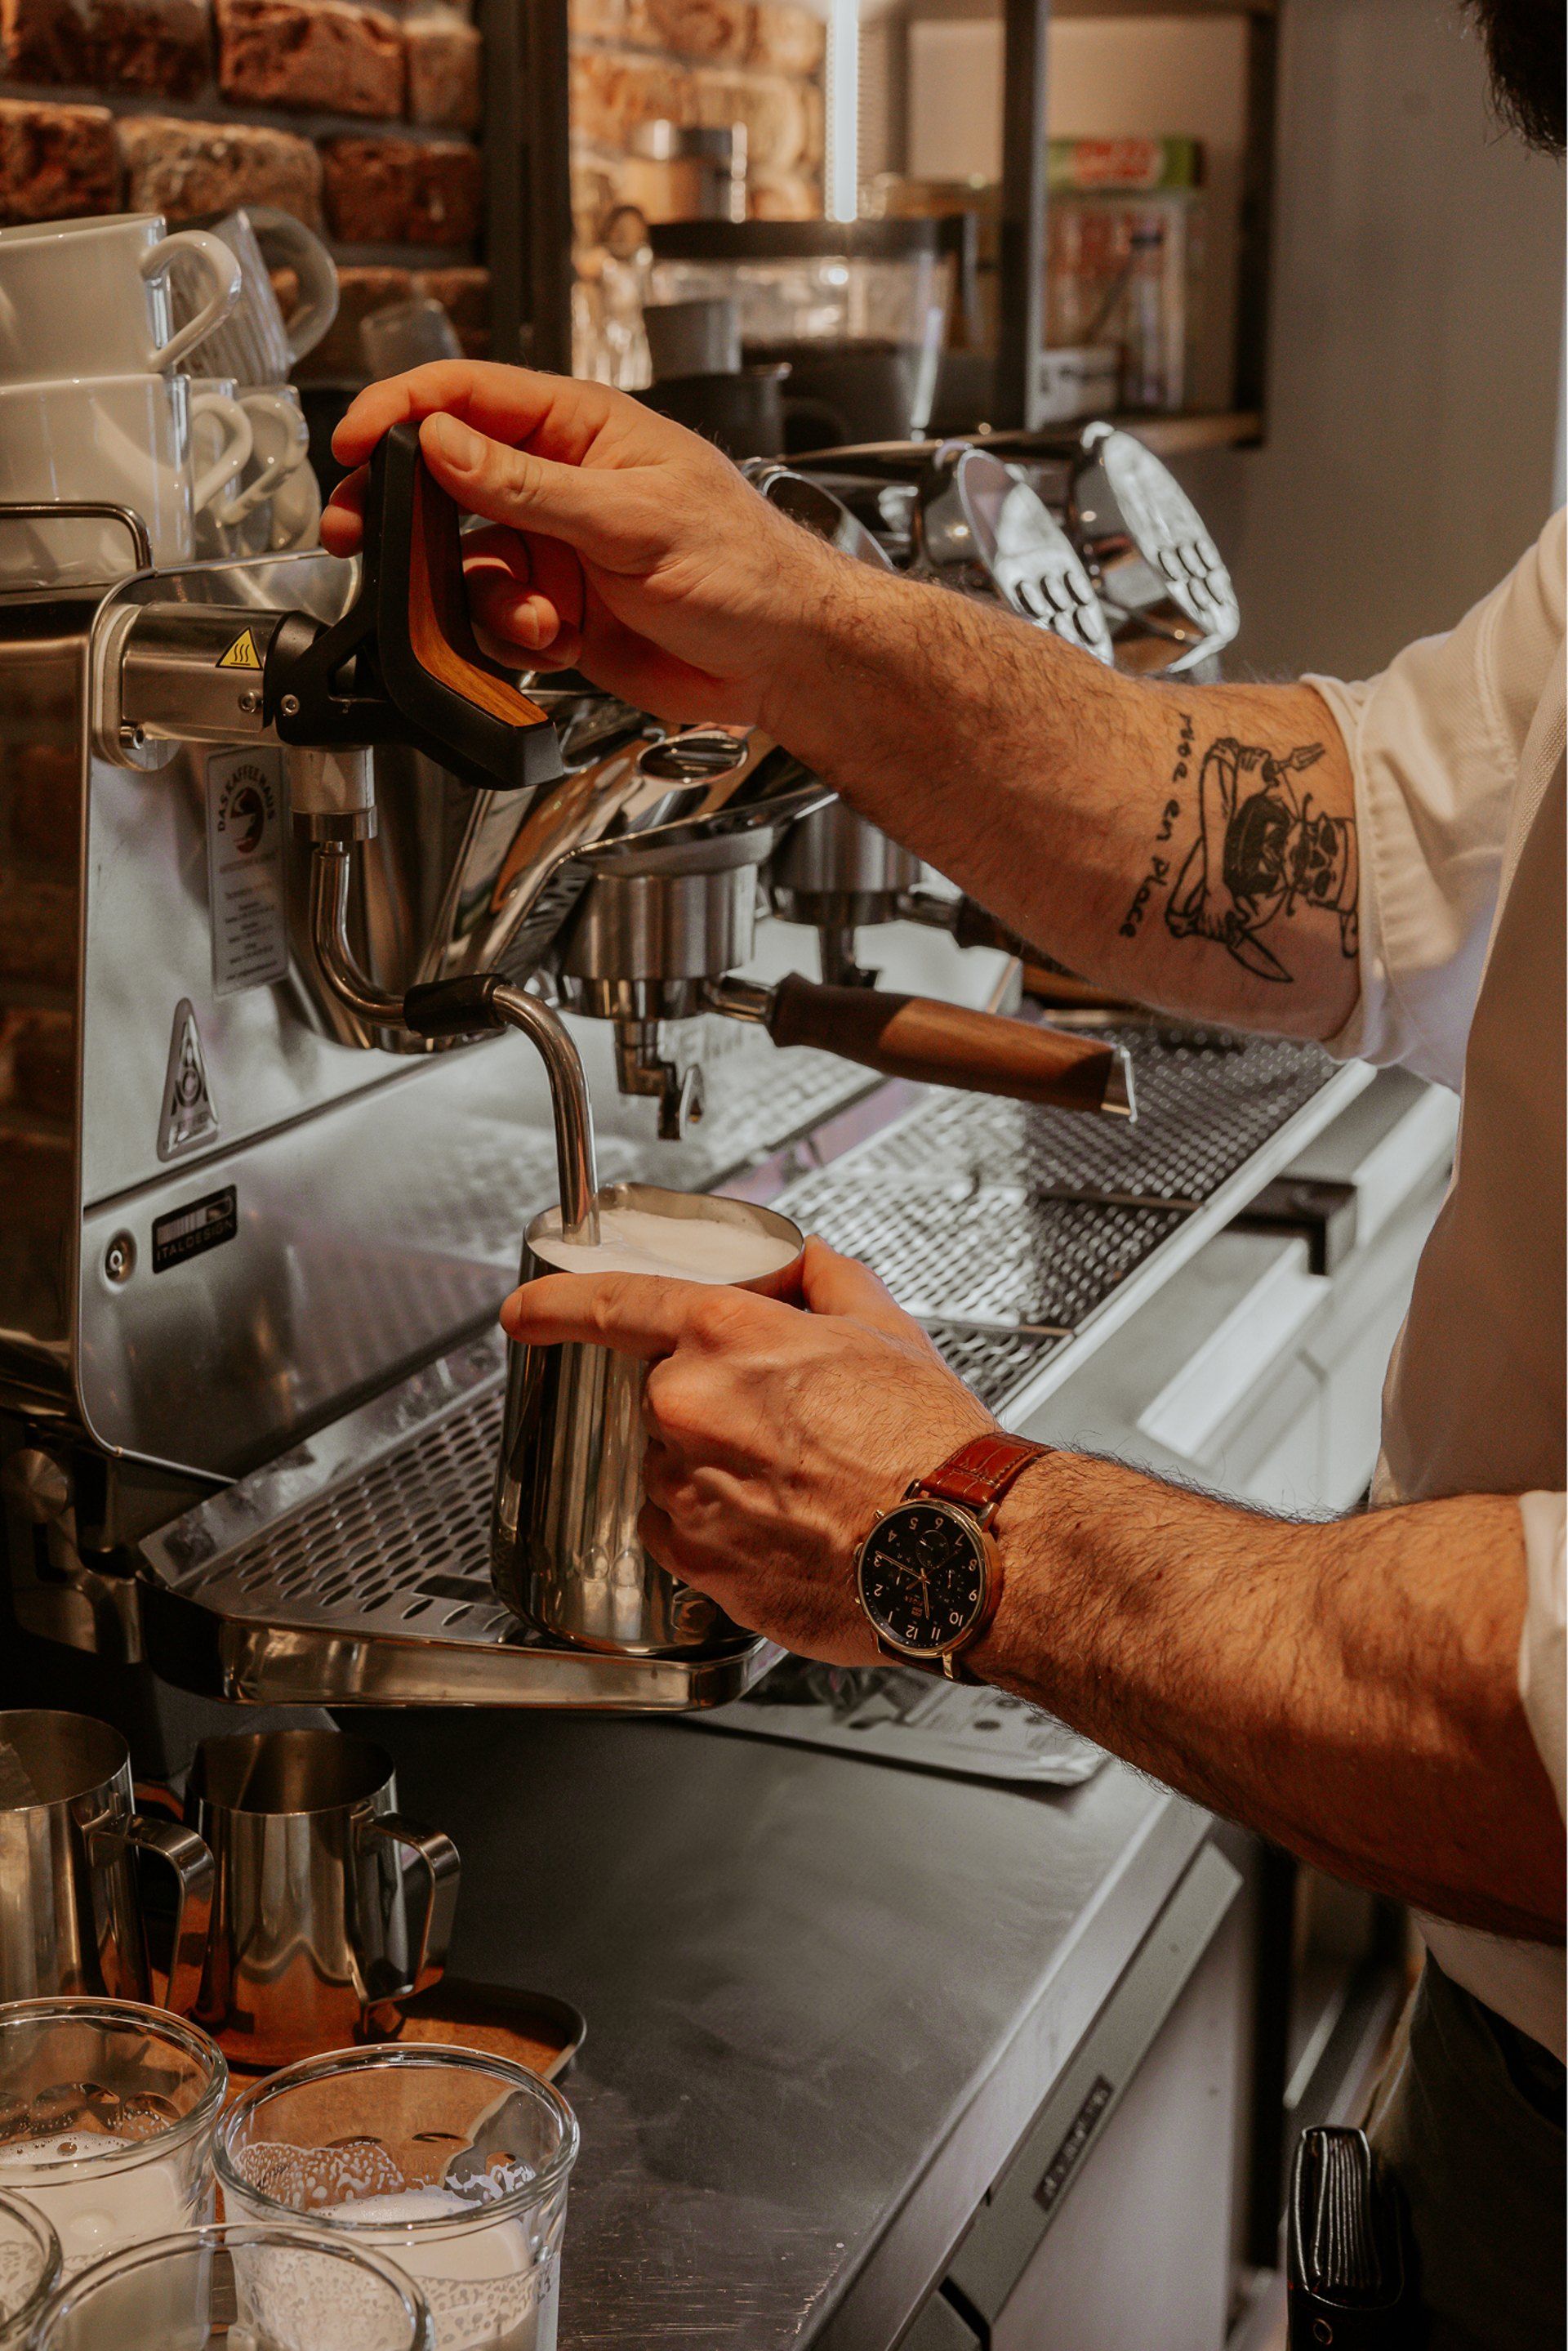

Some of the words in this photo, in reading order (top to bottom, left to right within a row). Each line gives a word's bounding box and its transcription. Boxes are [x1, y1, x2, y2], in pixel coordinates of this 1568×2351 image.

[217, 793, 229, 832] DAS
[909, 1517, 919, 1530] 5
[934, 1517, 944, 1530] 6
[888, 1529, 898, 1543] 4
[955, 1532, 966, 1547] 7
[968, 1559, 978, 1572] 8
[874, 1583, 884, 1597] 2
[968, 1588, 978, 1602] 9
[949, 1611, 964, 1627] 10
[905, 1624, 920, 1640] 12
[931, 1626, 941, 1641] 11
